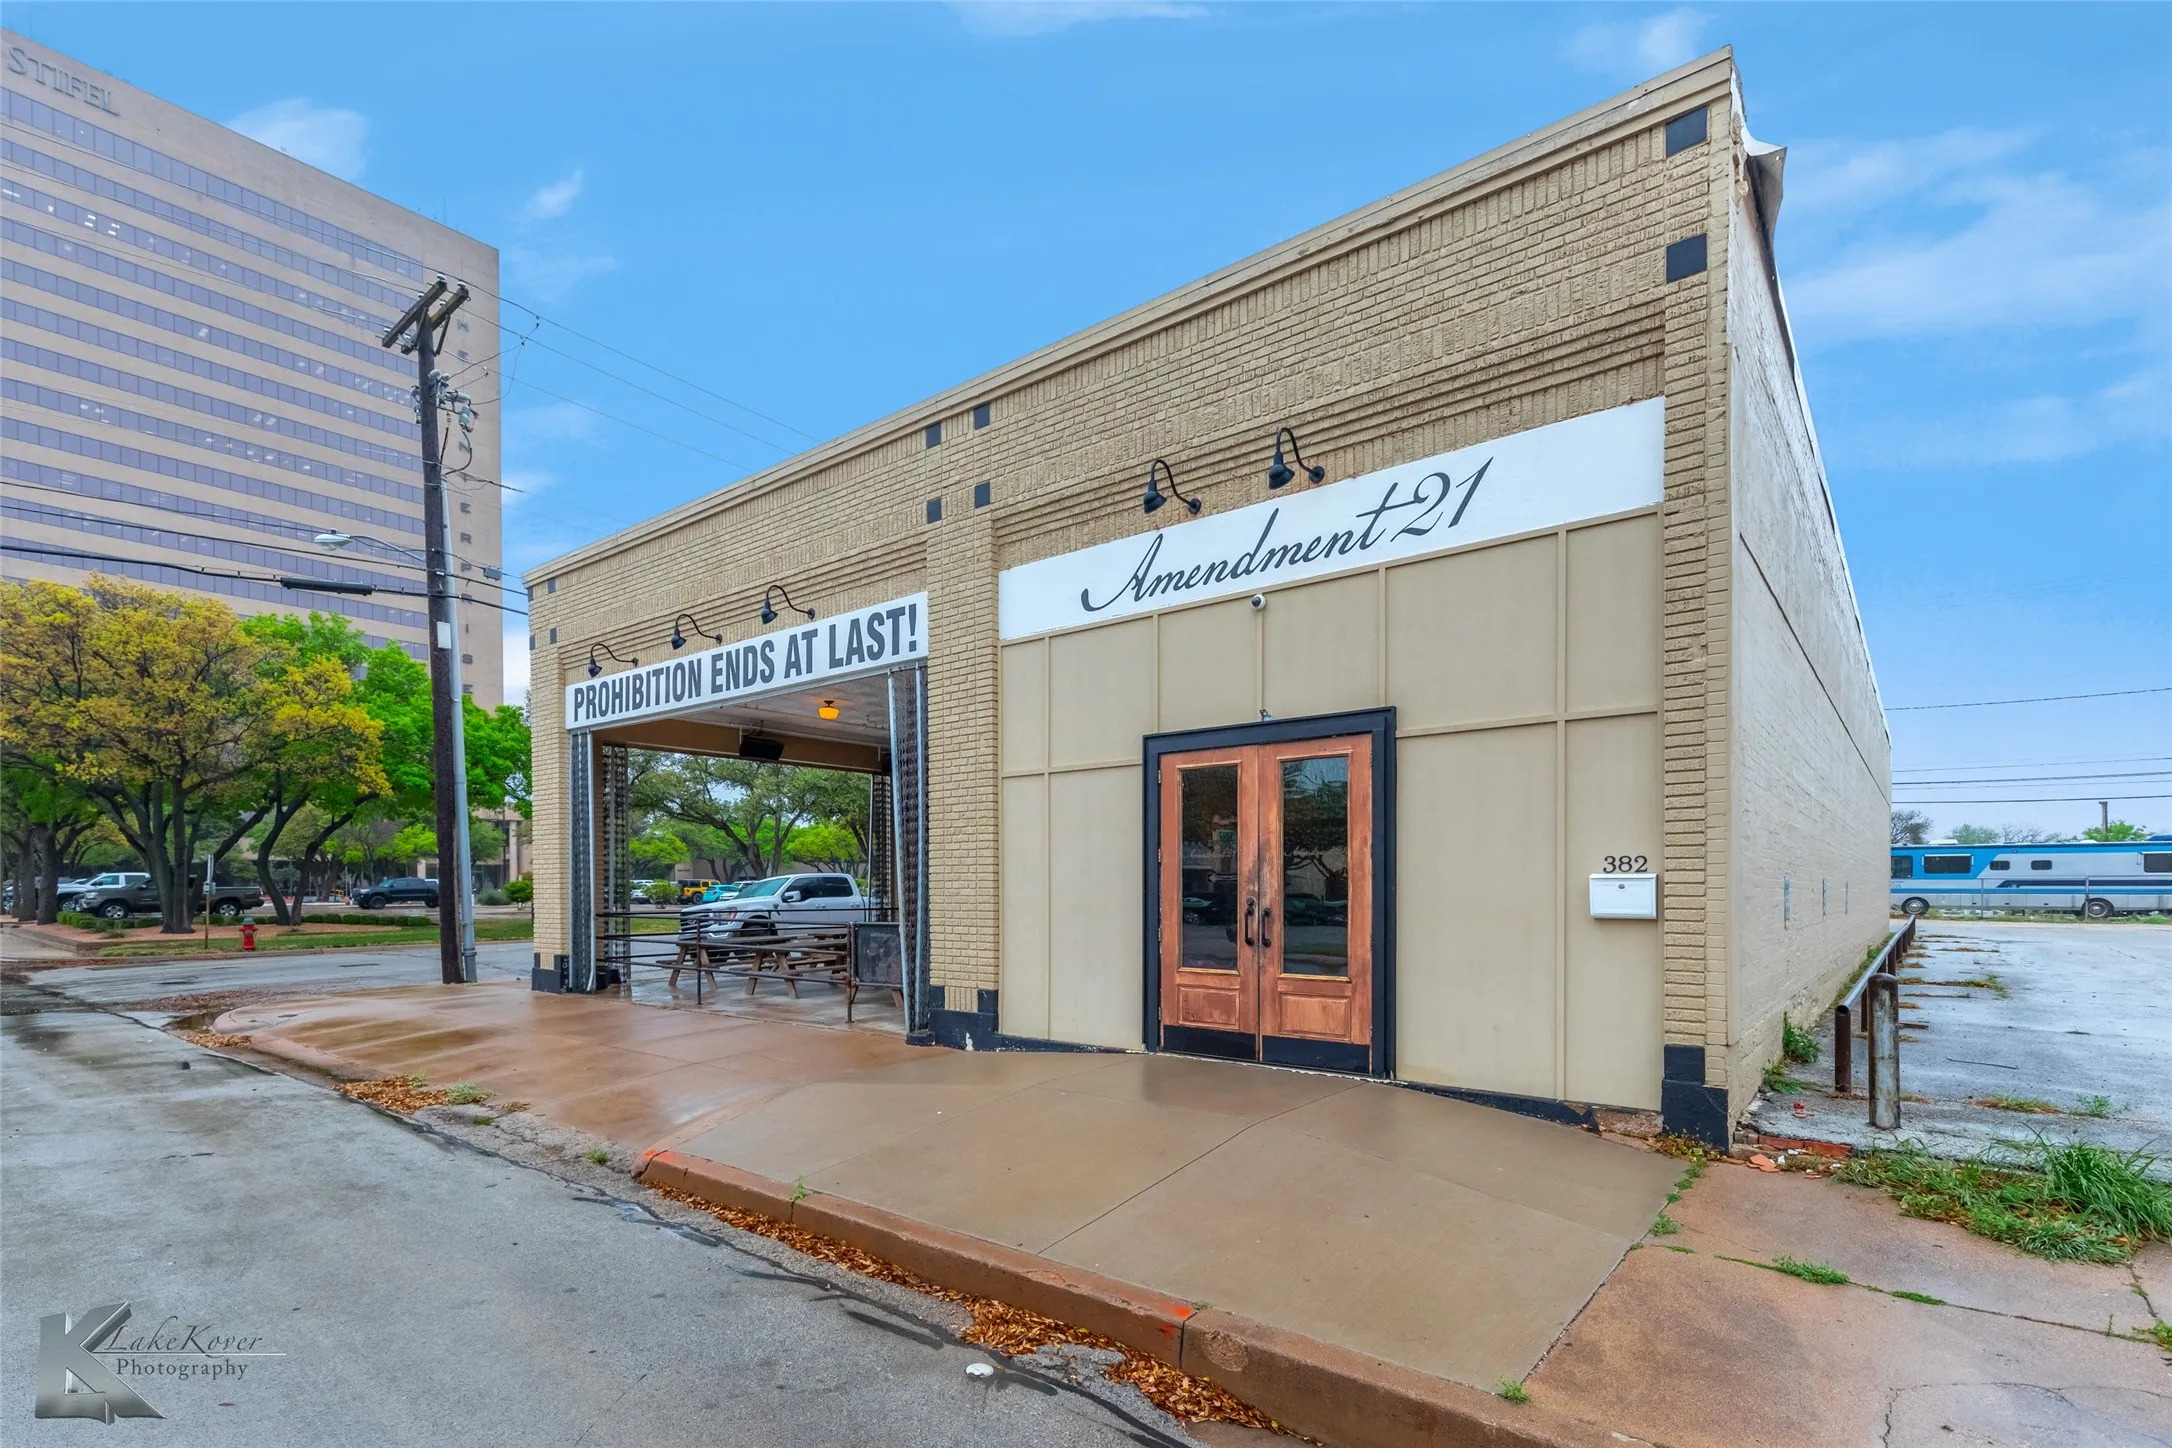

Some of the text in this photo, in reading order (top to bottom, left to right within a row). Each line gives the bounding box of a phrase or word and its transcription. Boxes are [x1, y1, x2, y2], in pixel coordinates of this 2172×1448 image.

[8, 47, 120, 117] STIFEL
[459, 408, 473, 694] NTERPRISE
[1080, 456, 1495, 612] Amendment 21
[574, 603, 918, 722] PROHIBITION ENDS AT LAST!
[1602, 855, 1648, 873] 382
